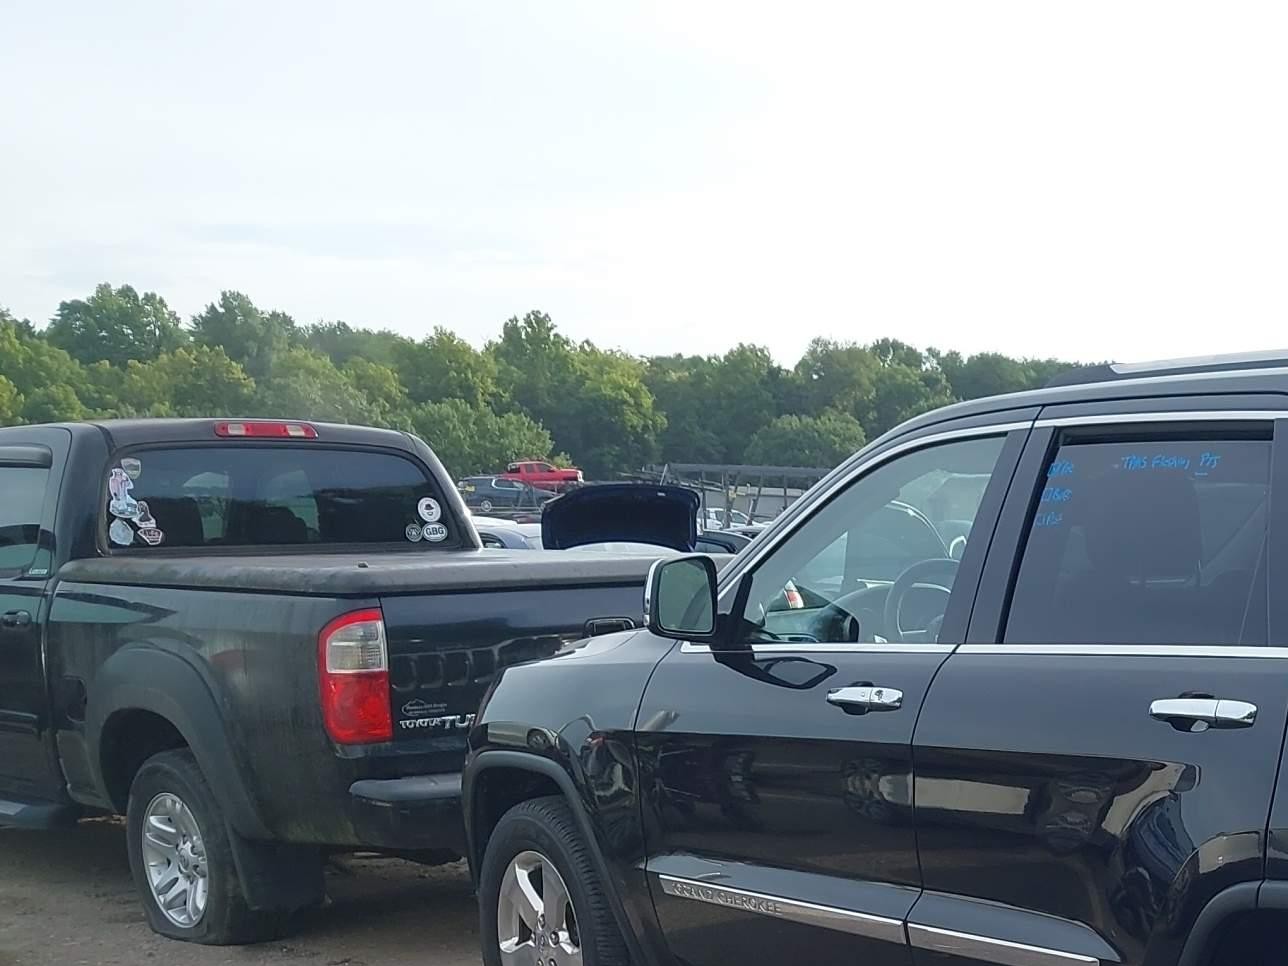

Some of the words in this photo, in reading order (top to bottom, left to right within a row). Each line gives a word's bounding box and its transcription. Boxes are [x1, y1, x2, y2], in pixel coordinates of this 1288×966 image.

[399, 718, 441, 729] TOYOTA
[671, 882, 713, 901] GRAND
[717, 892, 784, 916] CHEROKEE
